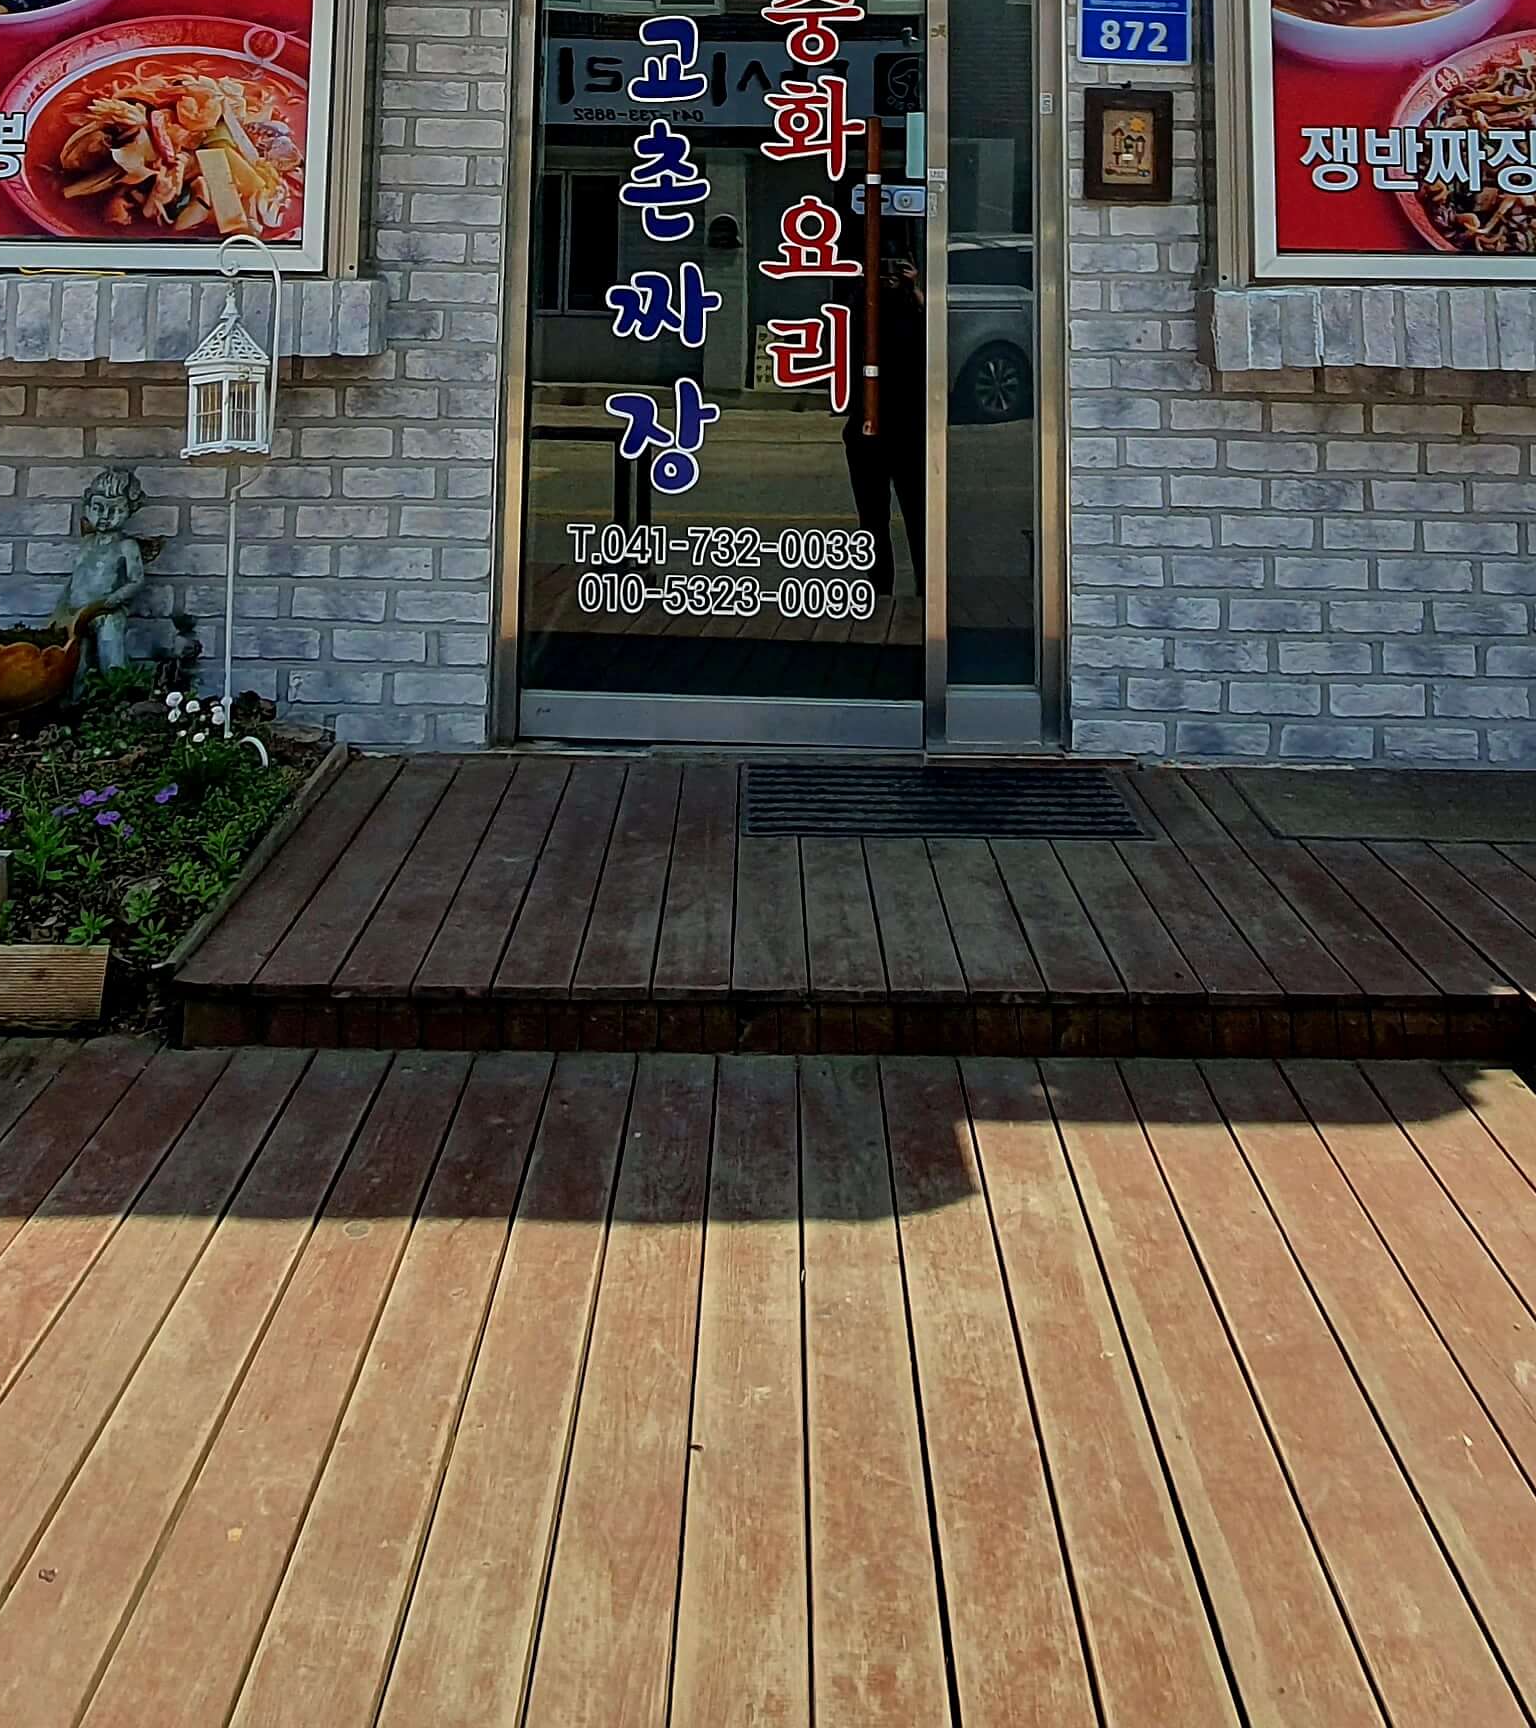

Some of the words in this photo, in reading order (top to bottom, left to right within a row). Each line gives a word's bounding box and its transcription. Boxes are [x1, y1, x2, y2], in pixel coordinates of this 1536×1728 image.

[1099, 19, 1169, 53] 872
[567, 524, 876, 570] T.041-732-0033
[578, 573, 876, 619] 010-5323-0099
